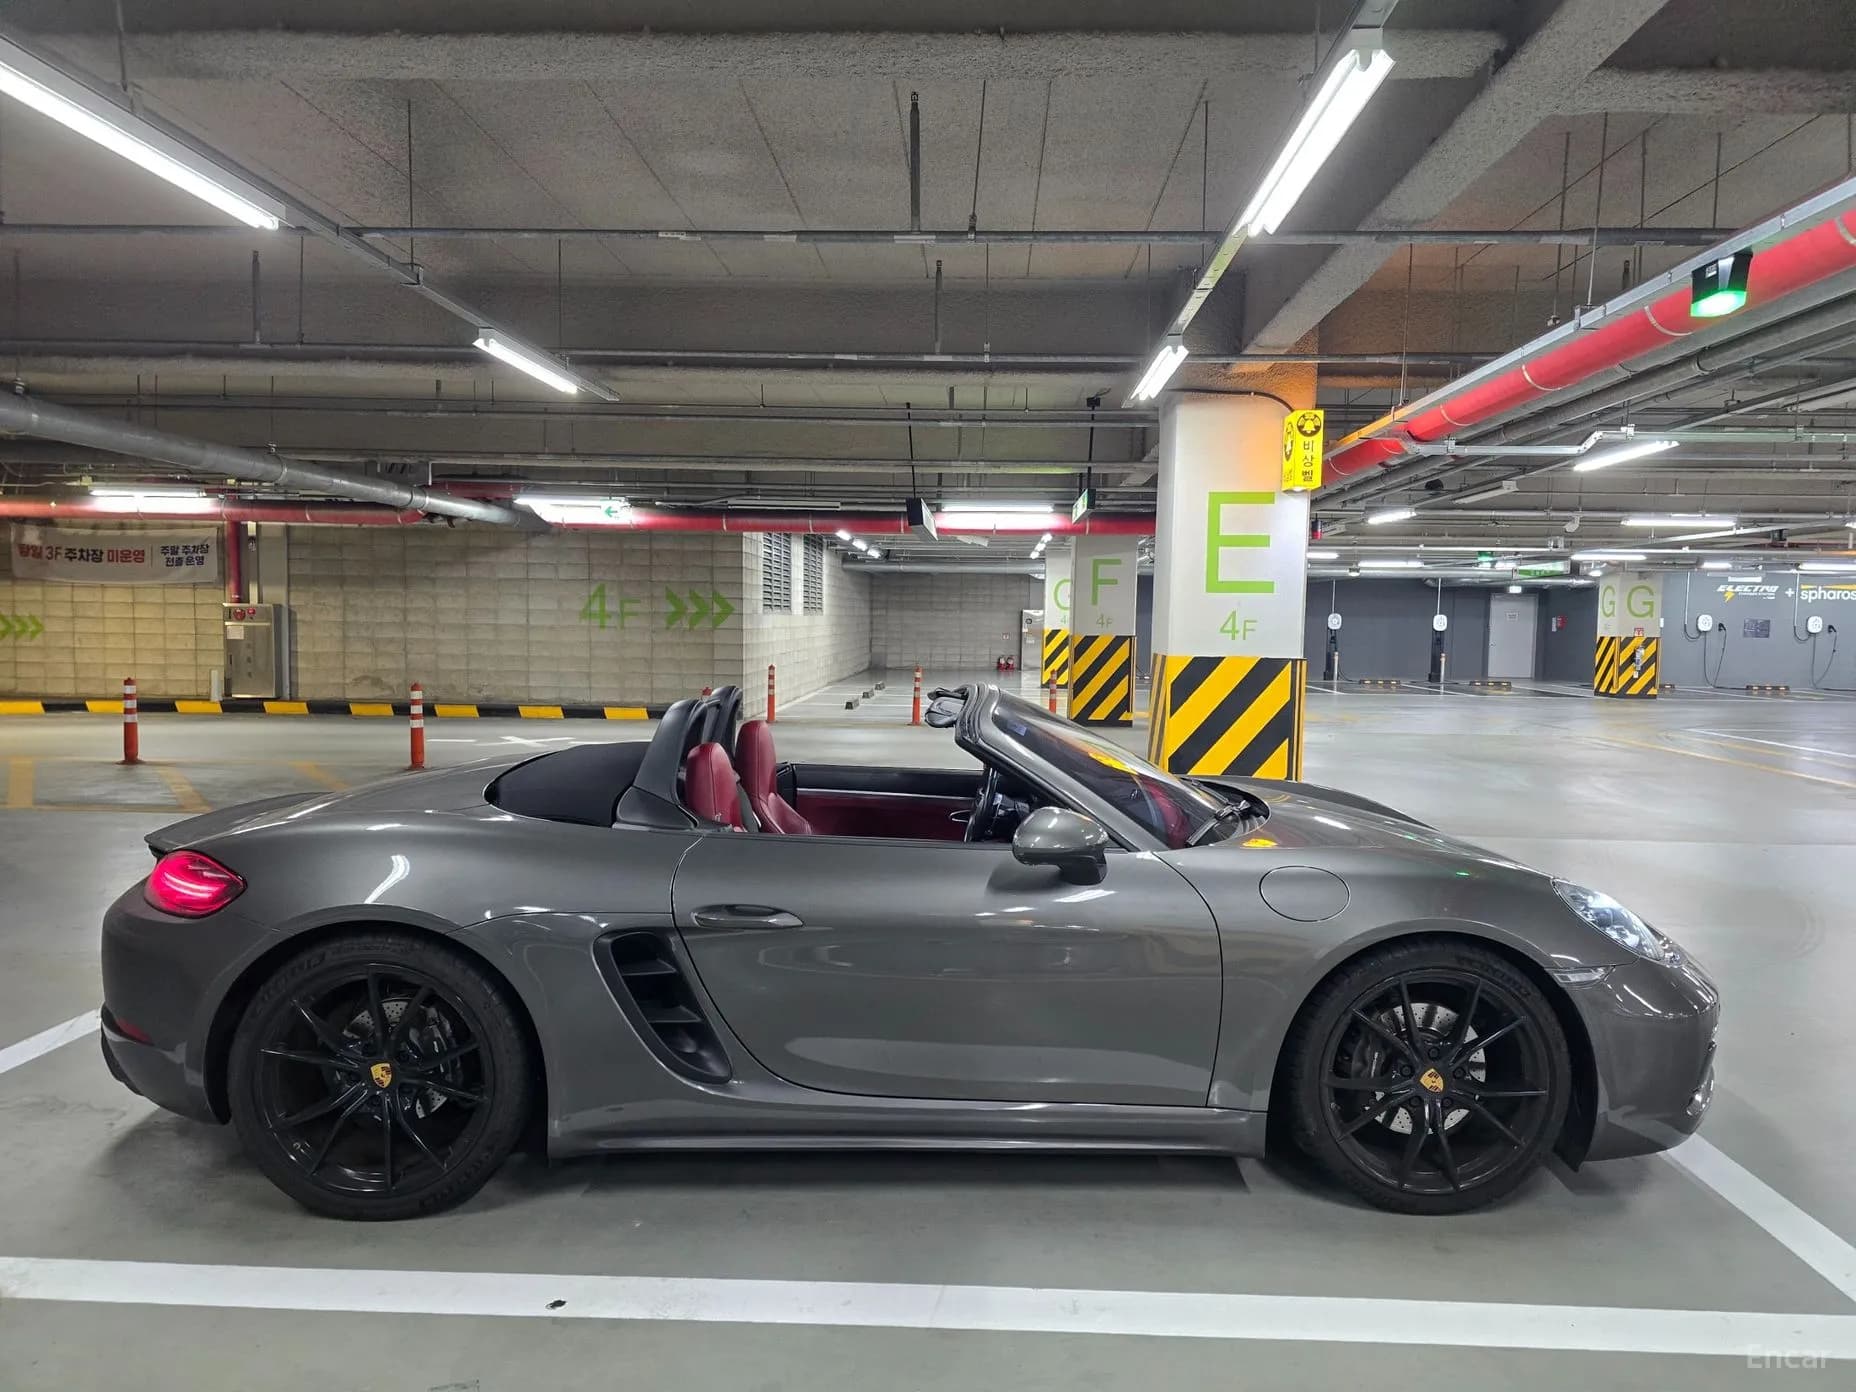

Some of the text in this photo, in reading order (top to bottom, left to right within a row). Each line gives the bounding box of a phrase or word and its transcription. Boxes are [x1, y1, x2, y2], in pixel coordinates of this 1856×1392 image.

[1302, 440, 1314, 482] 비상벨
[46, 545, 62, 561] 3F
[64, 547, 104, 563] 주차장
[107, 549, 145, 563] 미운영
[160, 543, 209, 556] 주말 주차장
[1206, 492, 1275, 593] E
[185, 556, 205, 566] 운영
[1091, 558, 1122, 605] F
[1800, 586, 1856, 603] spharos
[580, 583, 641, 630] 4F
[1602, 585, 1615, 618] G
[1627, 585, 1654, 618] G
[1096, 615, 1113, 627] 4F
[1219, 611, 1257, 641] 4F
